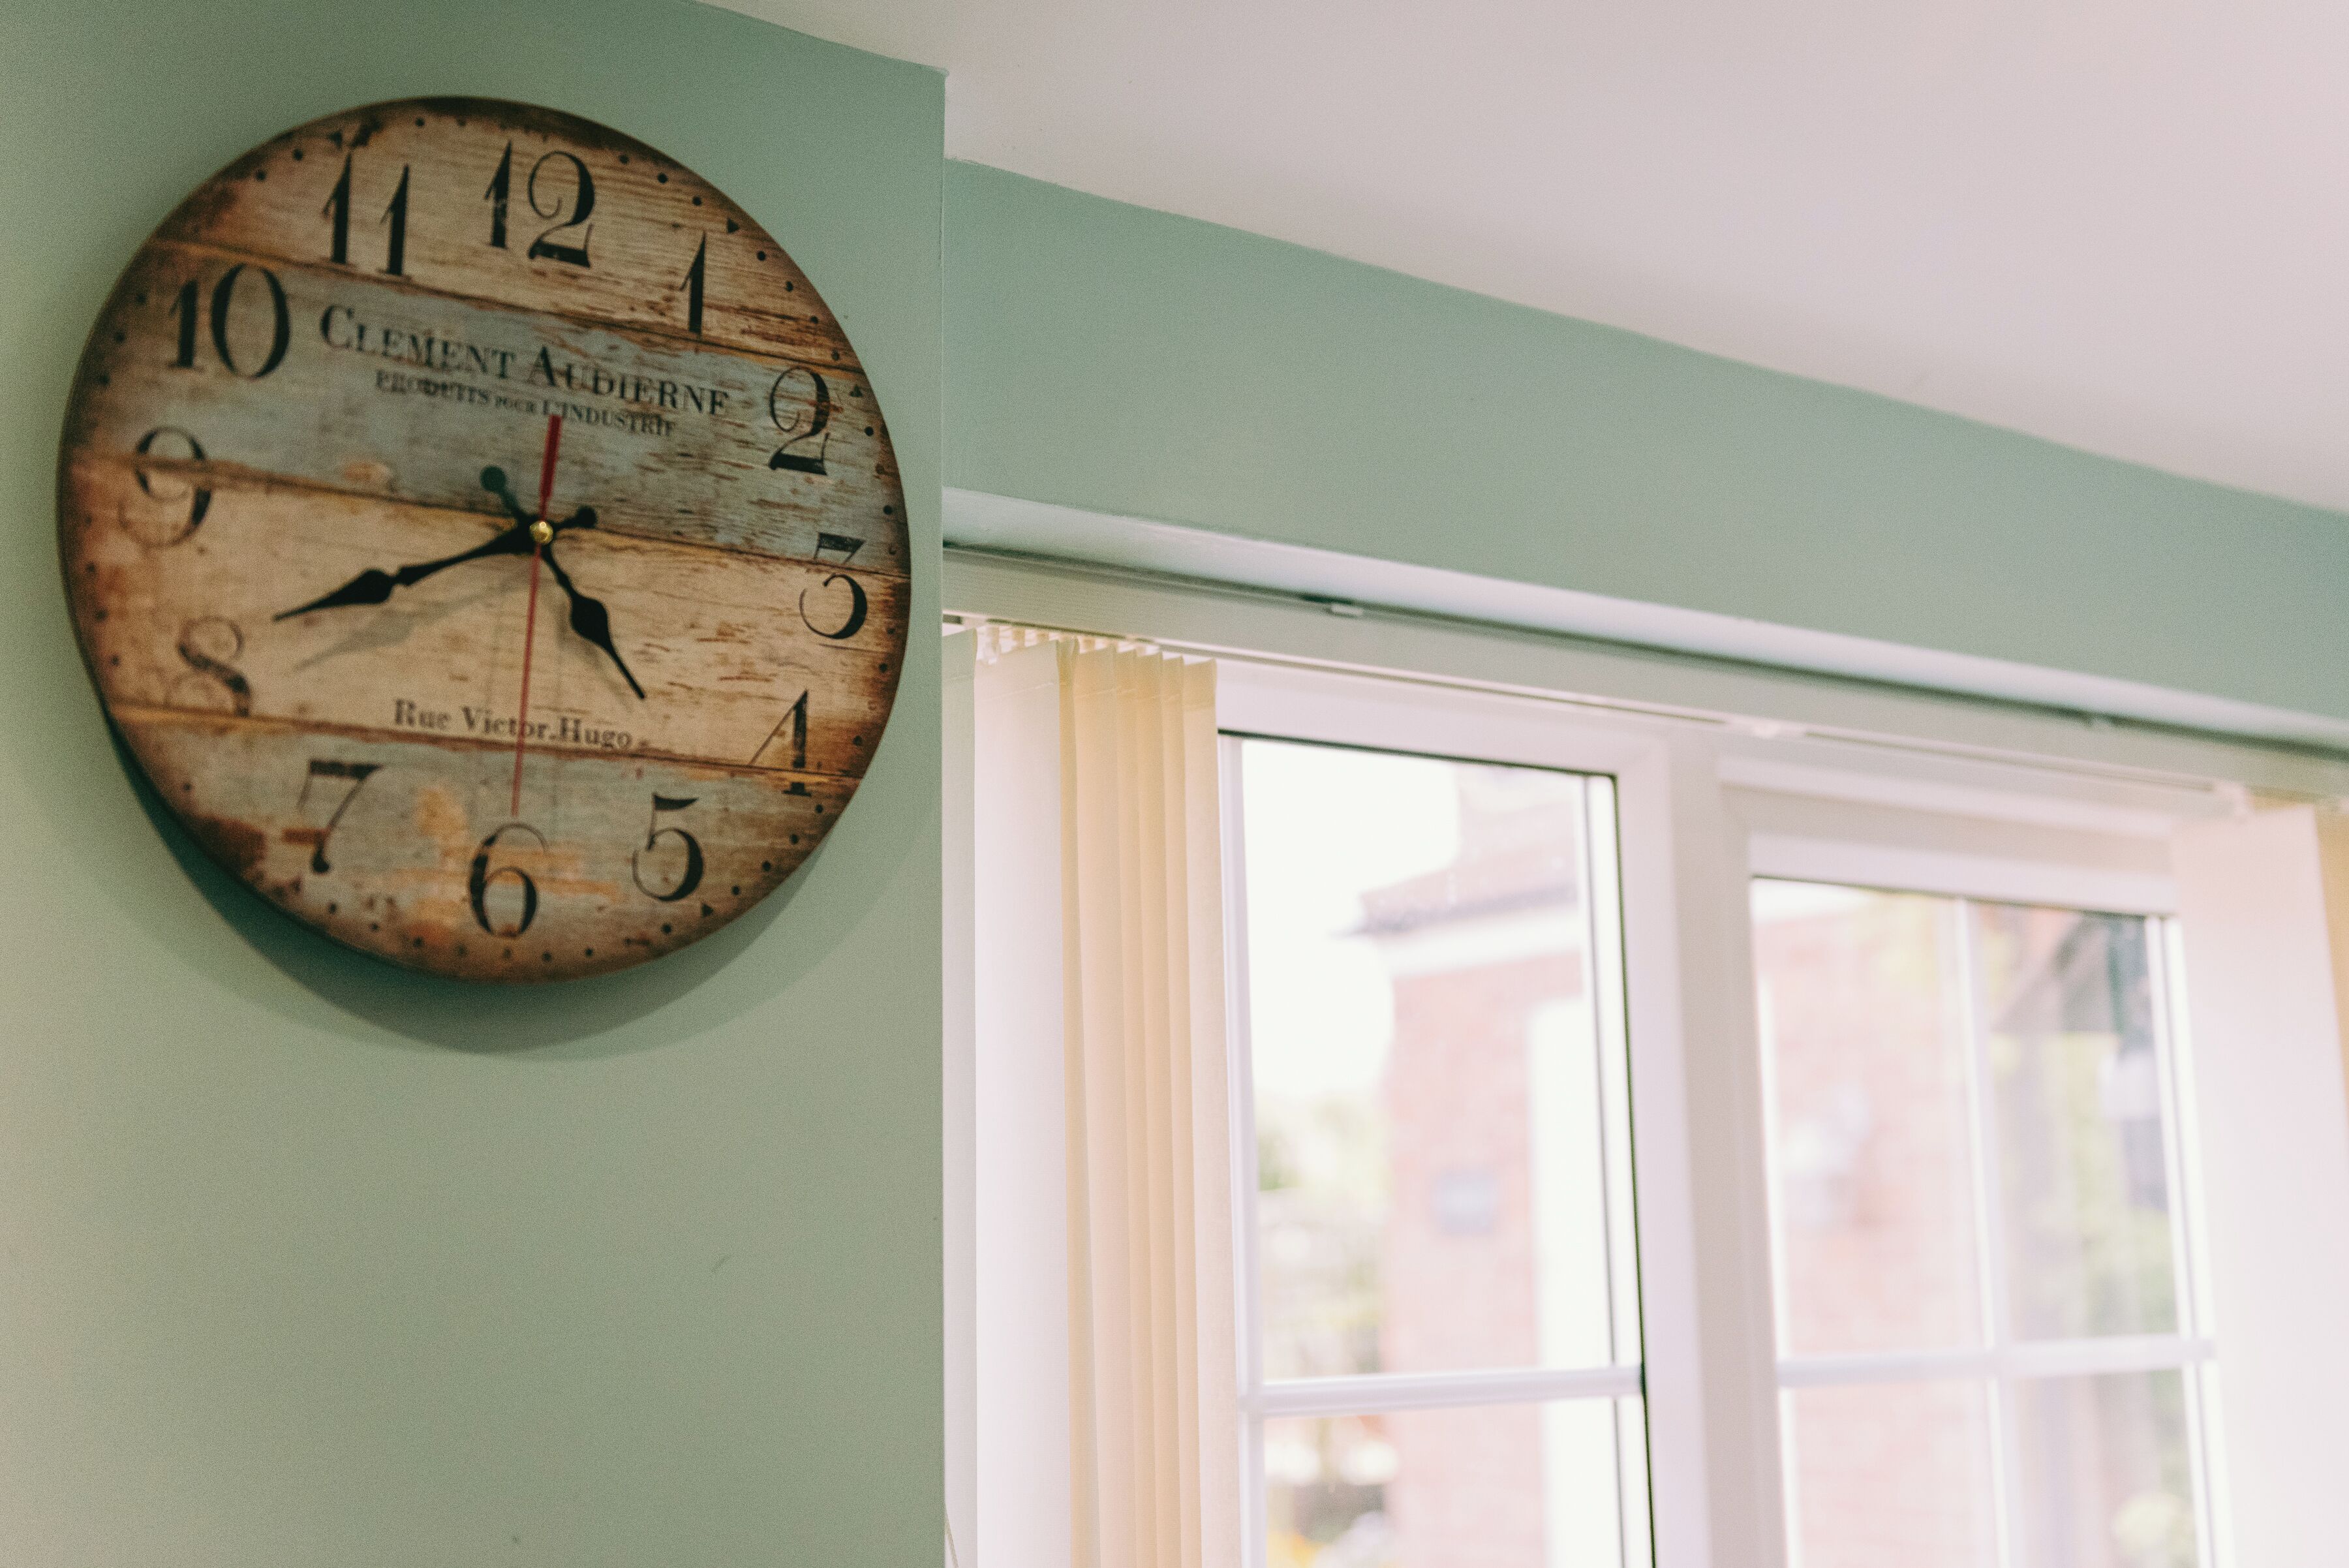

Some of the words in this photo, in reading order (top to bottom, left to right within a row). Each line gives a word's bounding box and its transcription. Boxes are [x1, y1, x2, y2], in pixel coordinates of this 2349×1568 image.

[322, 153, 412, 281] 11
[484, 139, 595, 268] 12
[168, 262, 291, 379] 10
[678, 230, 705, 336] 1
[319, 304, 517, 380] CLEMENT
[768, 367, 831, 476] 2
[119, 426, 213, 548] 9
[799, 532, 868, 639] 3
[166, 616, 253, 718] 8
[395, 698, 450, 730] Rue
[748, 688, 812, 797] 4
[298, 759, 384, 873] 7
[632, 792, 703, 902] 5
[468, 823, 549, 937] 6
